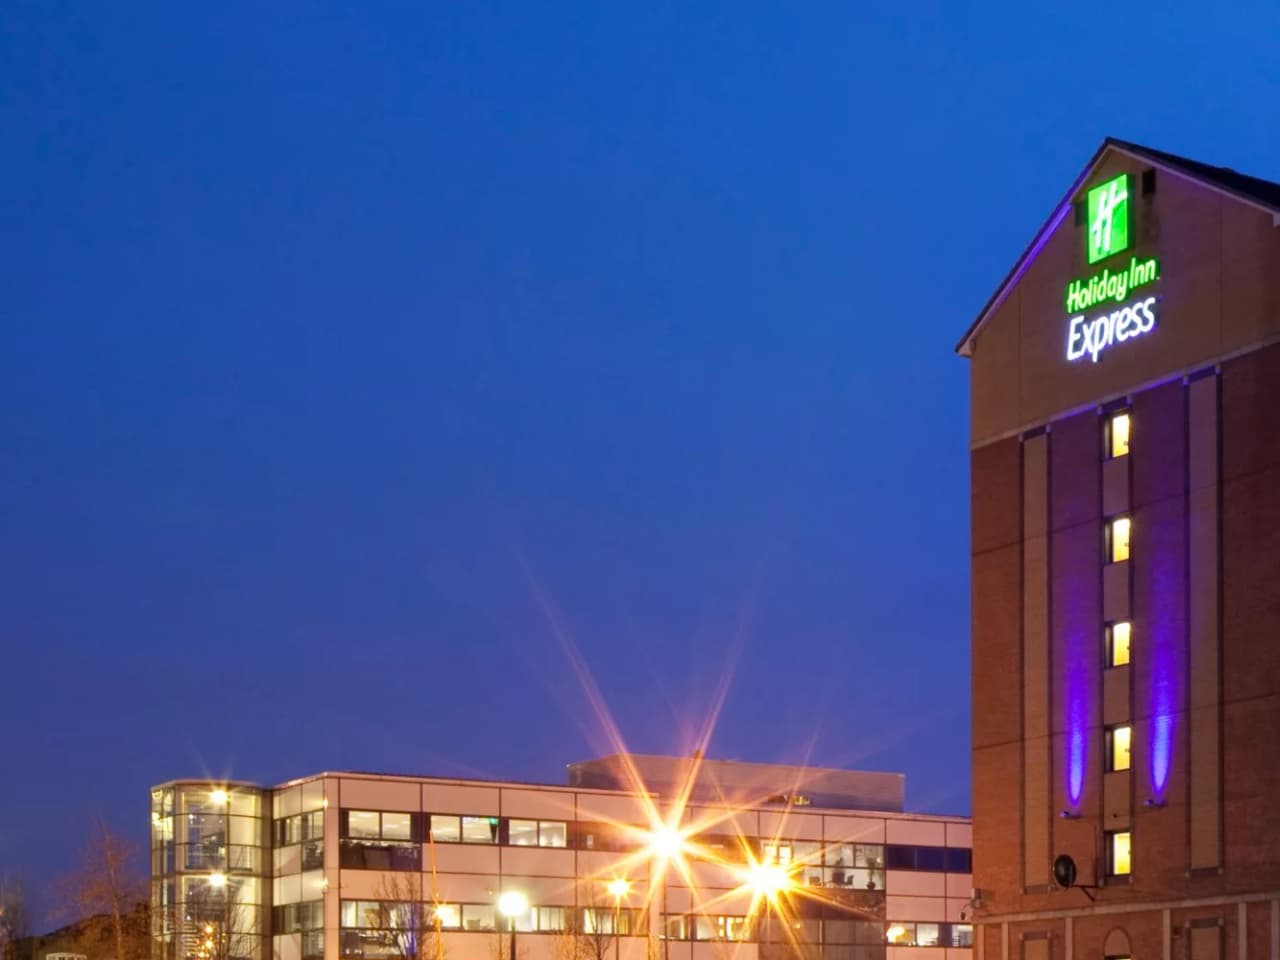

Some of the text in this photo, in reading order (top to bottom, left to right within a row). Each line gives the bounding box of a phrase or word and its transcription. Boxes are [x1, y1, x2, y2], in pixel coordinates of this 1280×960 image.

[1066, 257, 1156, 314] Holiday Inn
[1066, 297, 1157, 363] Express
